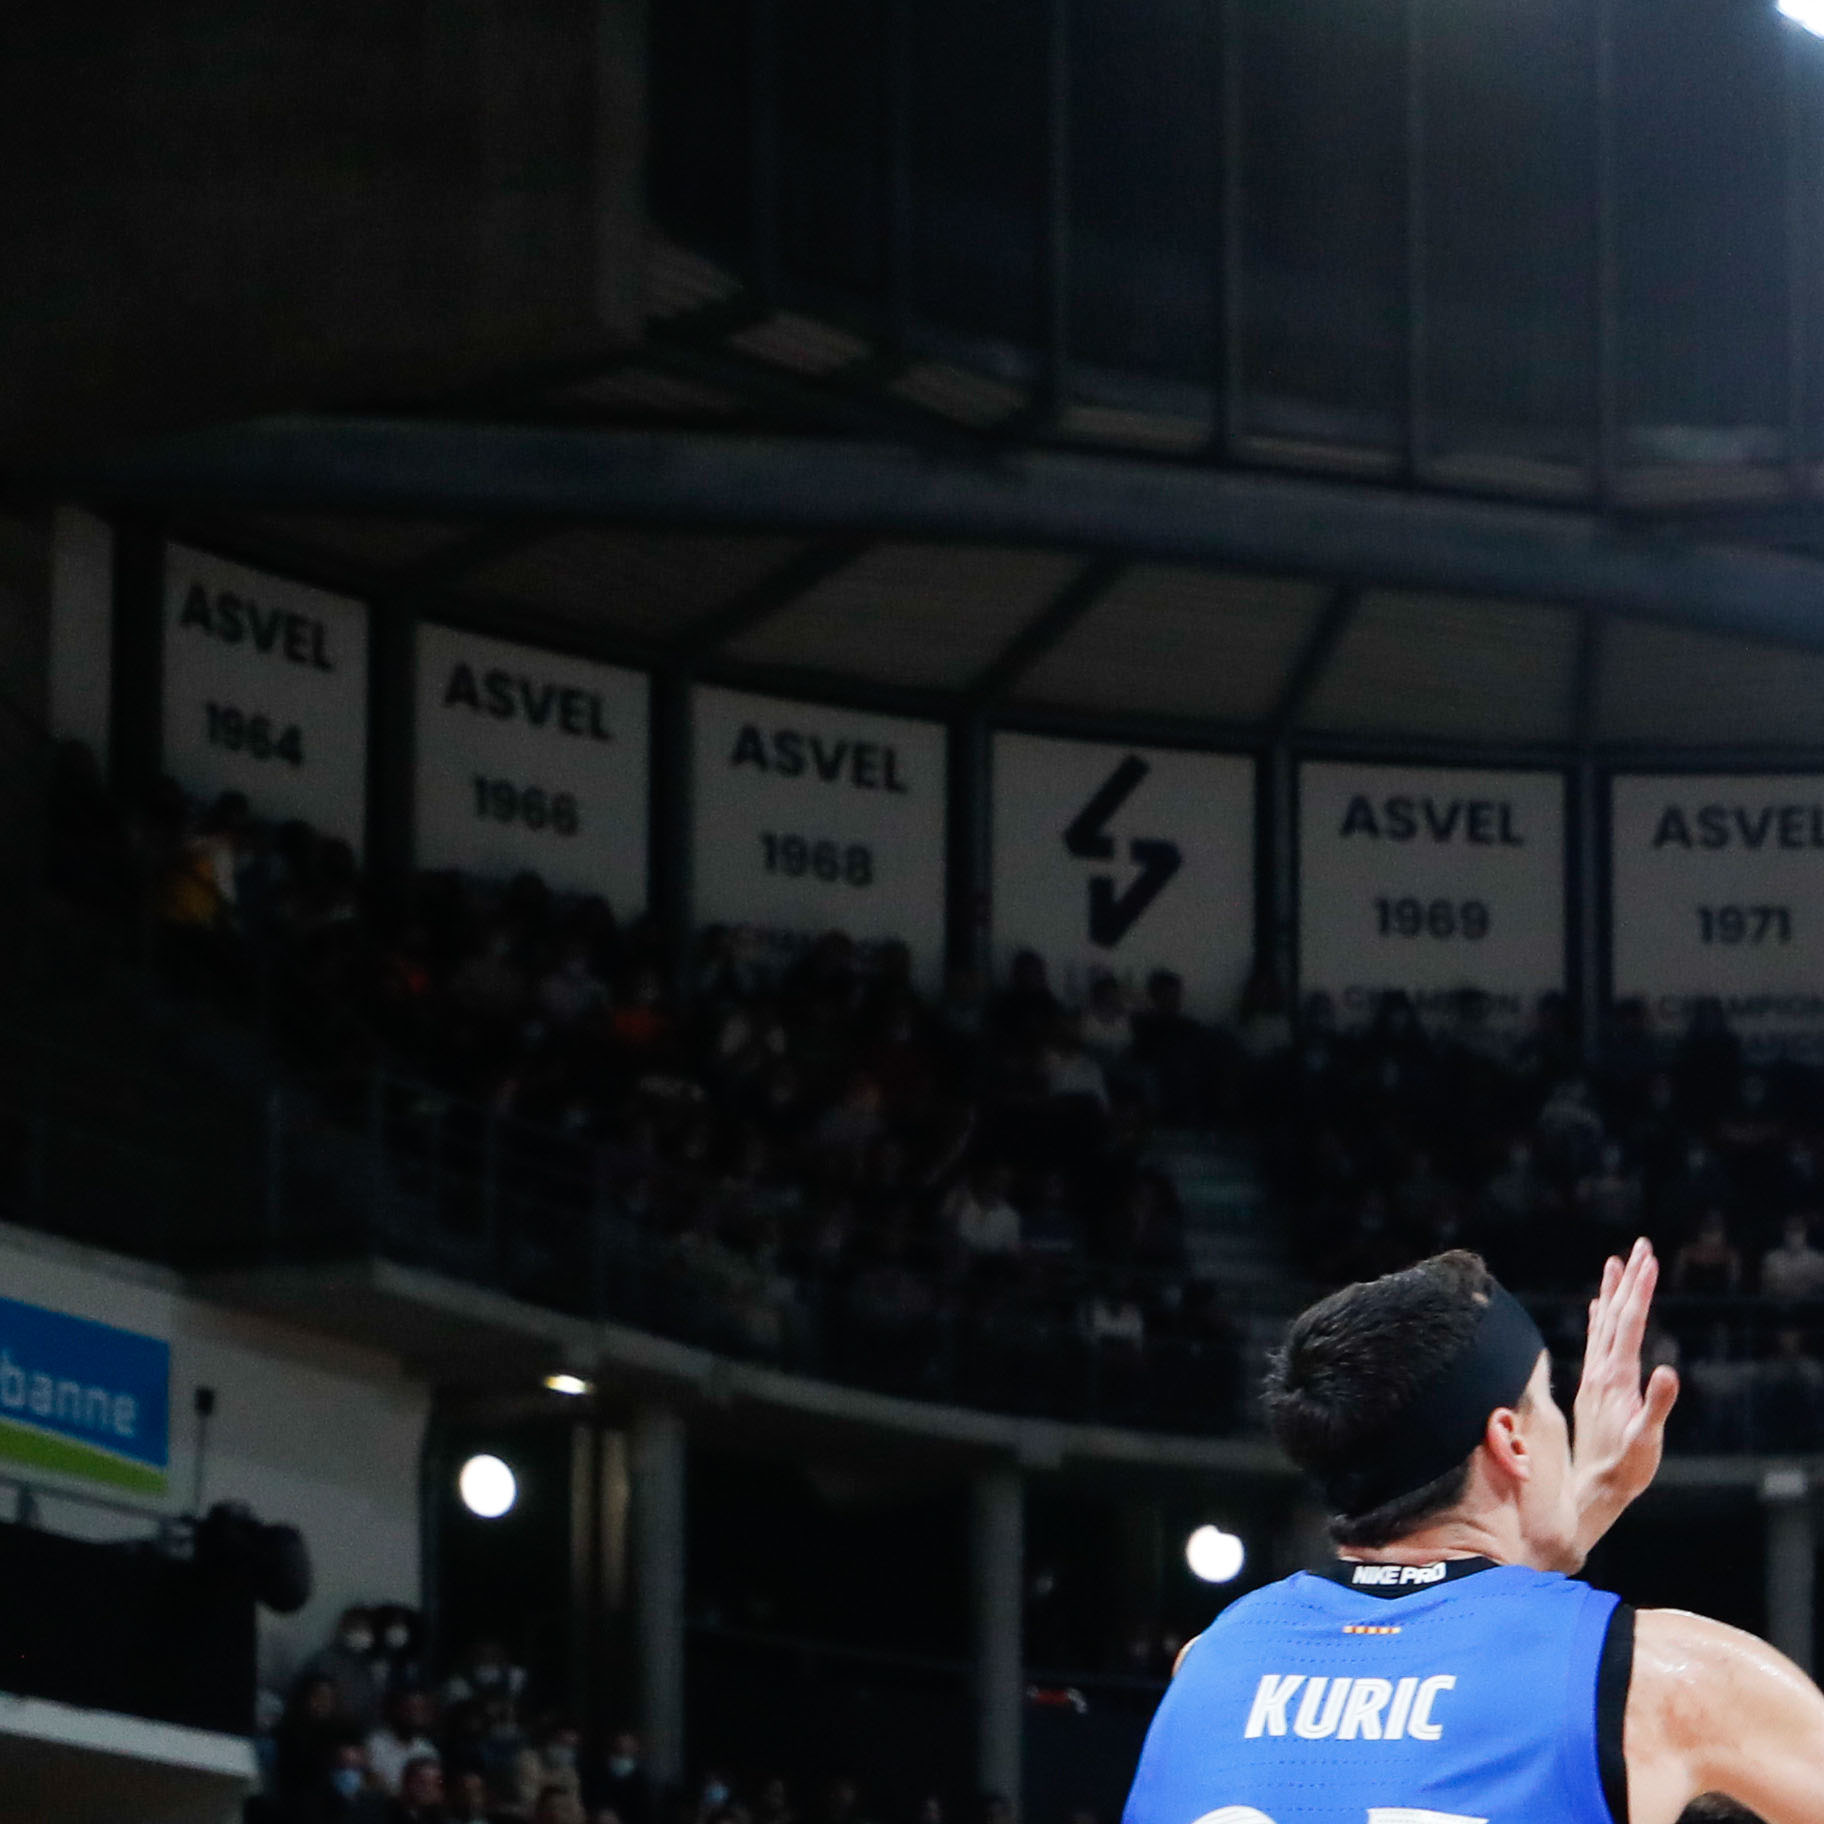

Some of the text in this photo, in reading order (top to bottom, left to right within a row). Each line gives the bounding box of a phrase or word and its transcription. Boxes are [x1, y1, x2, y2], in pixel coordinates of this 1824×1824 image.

[180, 583, 334, 673] ASVEL
[443, 661, 614, 743] ASVEL
[206, 701, 305, 768] 1964
[731, 722, 908, 796] ASVEL
[1339, 795, 1524, 848] ASVEL
[760, 830, 874, 888] 1968
[1373, 897, 1490, 941] 1969
[1697, 905, 1793, 946] 1971
[1352, 1562, 1447, 1585] NIKE PRO
[1244, 1674, 1456, 1741] KURIC
